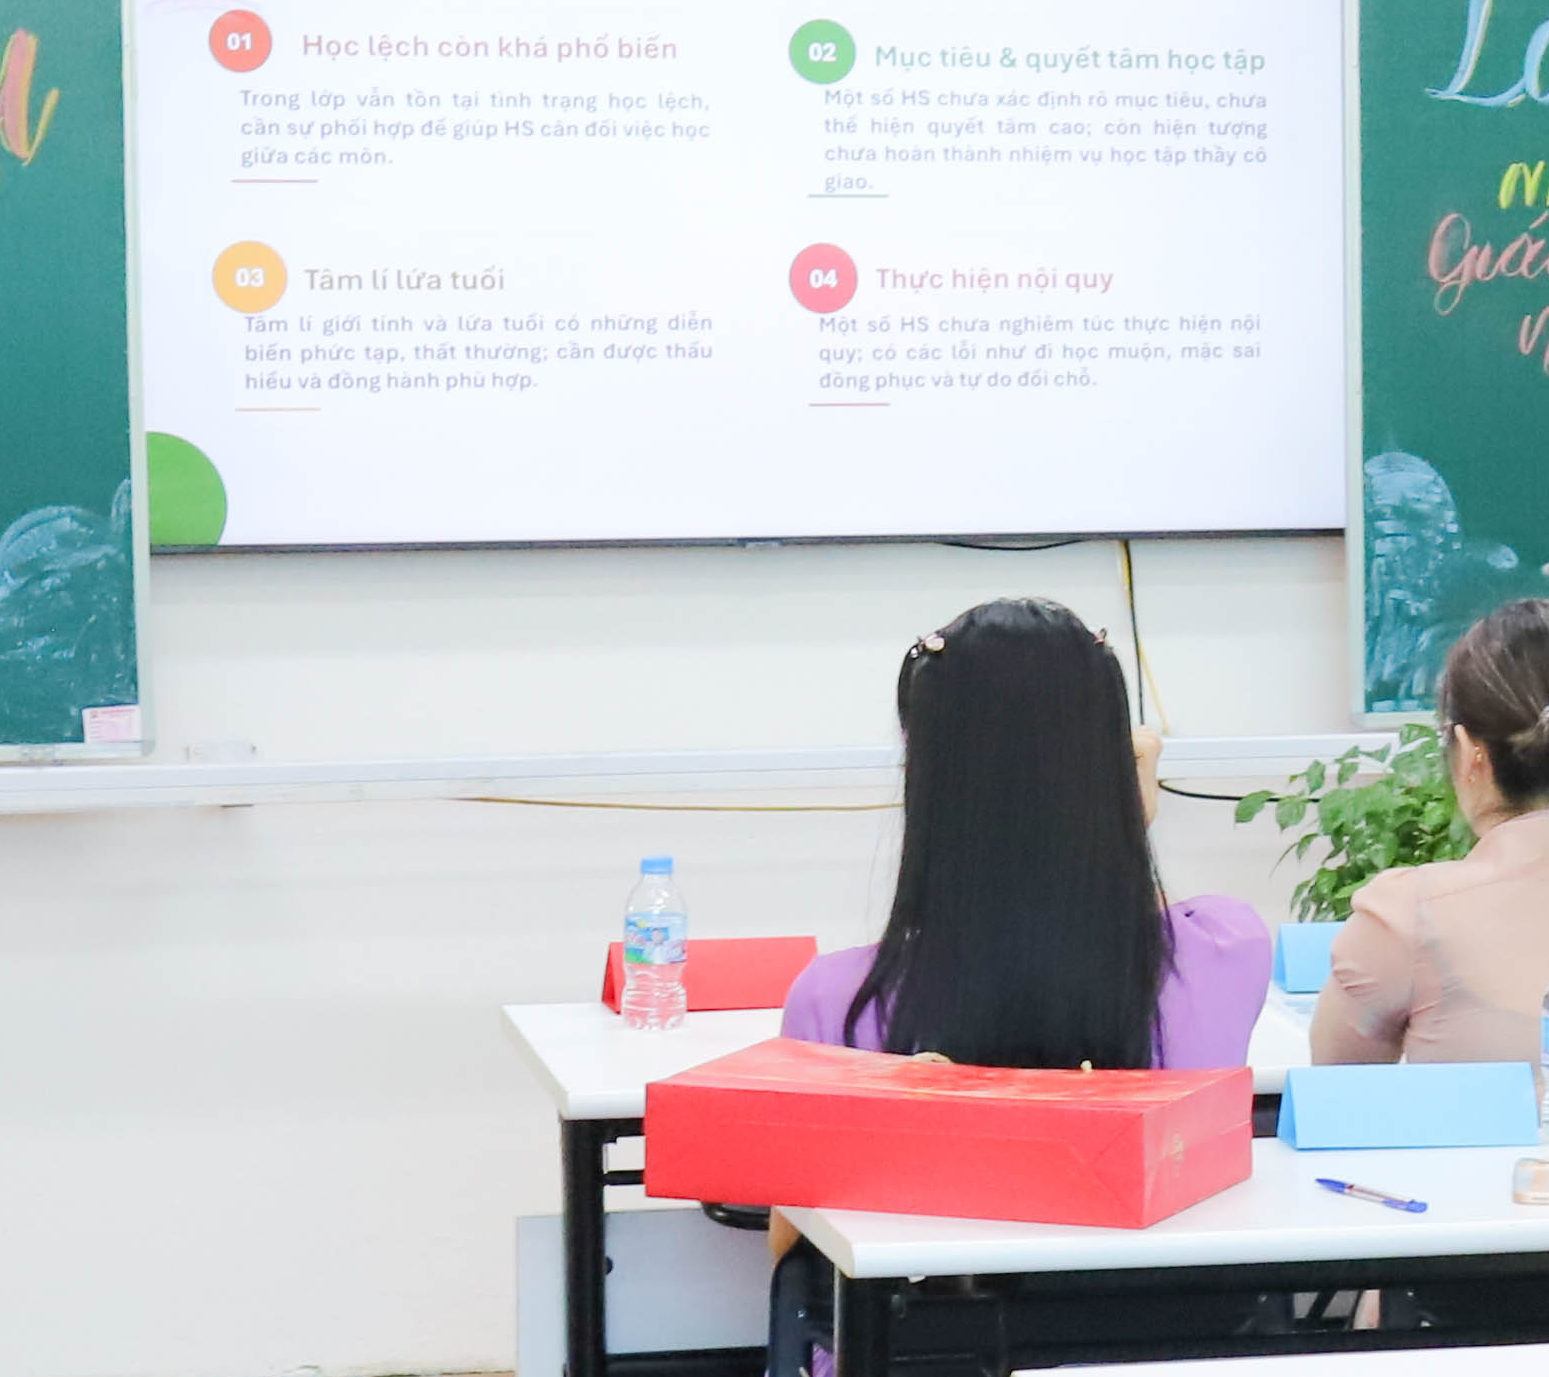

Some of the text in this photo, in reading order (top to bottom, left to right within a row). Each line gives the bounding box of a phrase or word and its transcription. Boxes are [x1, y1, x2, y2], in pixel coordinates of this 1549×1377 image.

[226, 31, 253, 51] 01
[302, 33, 360, 61] Học
[368, 32, 429, 61] lệch
[437, 33, 490, 59] còn
[497, 35, 549, 60] khá
[617, 33, 678, 61] biến
[807, 42, 838, 63] 02
[875, 43, 1266, 76] Mục tiêu & quyết tâm học tập
[239, 88, 301, 113] Trong
[310, 88, 347, 112] lớp
[451, 90, 480, 113] tại
[541, 92, 598, 115] trạng
[608, 92, 648, 114] học
[823, 88, 864, 110] Một
[900, 87, 932, 107] HS
[936, 89, 990, 108] chưa
[995, 89, 1031, 109] xác
[1114, 93, 1159, 111] mục
[1215, 90, 1268, 110] chưa
[373, 118, 416, 141] hợp
[504, 119, 536, 139] HS
[622, 118, 666, 143] việc
[671, 120, 711, 143] học
[870, 116, 915, 138] hiện
[926, 115, 985, 138] quyết
[1153, 117, 1197, 139] hiện
[1207, 119, 1269, 140] tượng
[293, 147, 332, 167] các
[823, 144, 878, 163] chưa
[1078, 149, 1103, 166] vụ
[1109, 145, 1148, 166] học
[1153, 145, 1188, 167] tập
[235, 267, 265, 288] 03
[303, 268, 363, 292] Tâm
[371, 267, 389, 291] lí
[396, 268, 442, 291] lứa
[808, 269, 839, 290] 04
[875, 266, 1114, 296] Thực hiện nội quy
[298, 313, 313, 333] lí
[554, 314, 580, 333] có
[818, 314, 858, 336] Một
[899, 314, 930, 334] HS
[937, 314, 991, 333] chưa
[1122, 315, 1170, 336] thực
[1178, 314, 1223, 336] hiện
[1230, 314, 1261, 336] nội
[299, 343, 356, 366] phức
[363, 344, 406, 365] tạp,
[602, 341, 658, 363] được
[871, 341, 897, 362] có
[905, 342, 943, 361] các
[985, 342, 1028, 360] như
[1061, 341, 1100, 364] học
[1232, 342, 1261, 360] sai
[874, 370, 926, 392] phục
[958, 371, 983, 391] tự
[986, 370, 1013, 389] do
